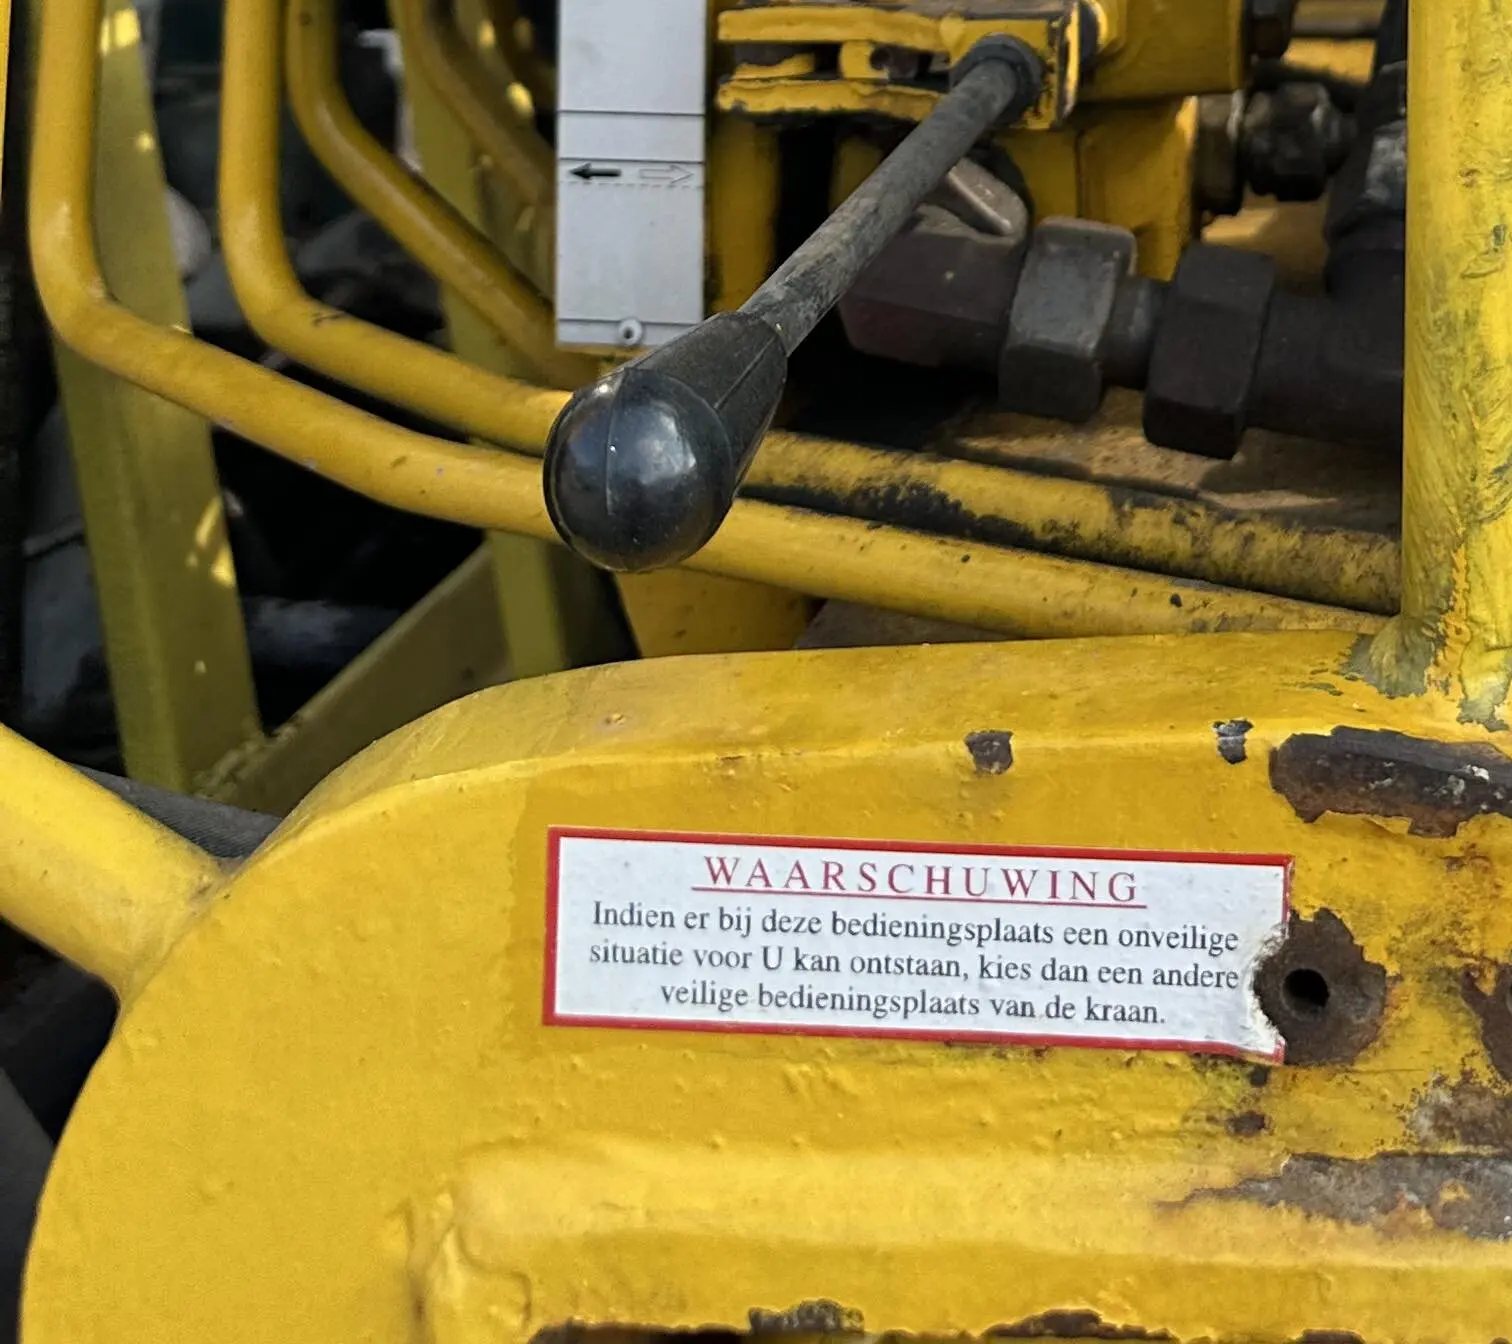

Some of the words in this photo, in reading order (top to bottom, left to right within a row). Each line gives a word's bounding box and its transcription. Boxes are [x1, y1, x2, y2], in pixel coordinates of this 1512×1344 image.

[704, 855, 1137, 902] WAARSCHUWING
[593, 900, 676, 929] Indien
[683, 912, 710, 930] er
[718, 906, 752, 938] bij
[761, 909, 822, 934] deze
[831, 911, 1053, 948] bedieningsplaats
[1063, 927, 1108, 946] een
[1117, 924, 1240, 957] onveilige
[588, 938, 684, 966] situatie
[693, 948, 753, 969] voor
[761, 946, 784, 971] U
[792, 947, 841, 973] kan
[850, 950, 969, 981] ontstaan,
[979, 954, 1032, 981] kies
[1040, 958, 1089, 983] dan
[1097, 965, 1143, 985] een
[1152, 963, 1240, 989] andere
[660, 979, 749, 1012] veilige
[758, 983, 980, 1020] bedieningsplaats
[991, 999, 1036, 1018] van
[1044, 995, 1076, 1020] de
[1084, 1001, 1166, 1024] kraan.
